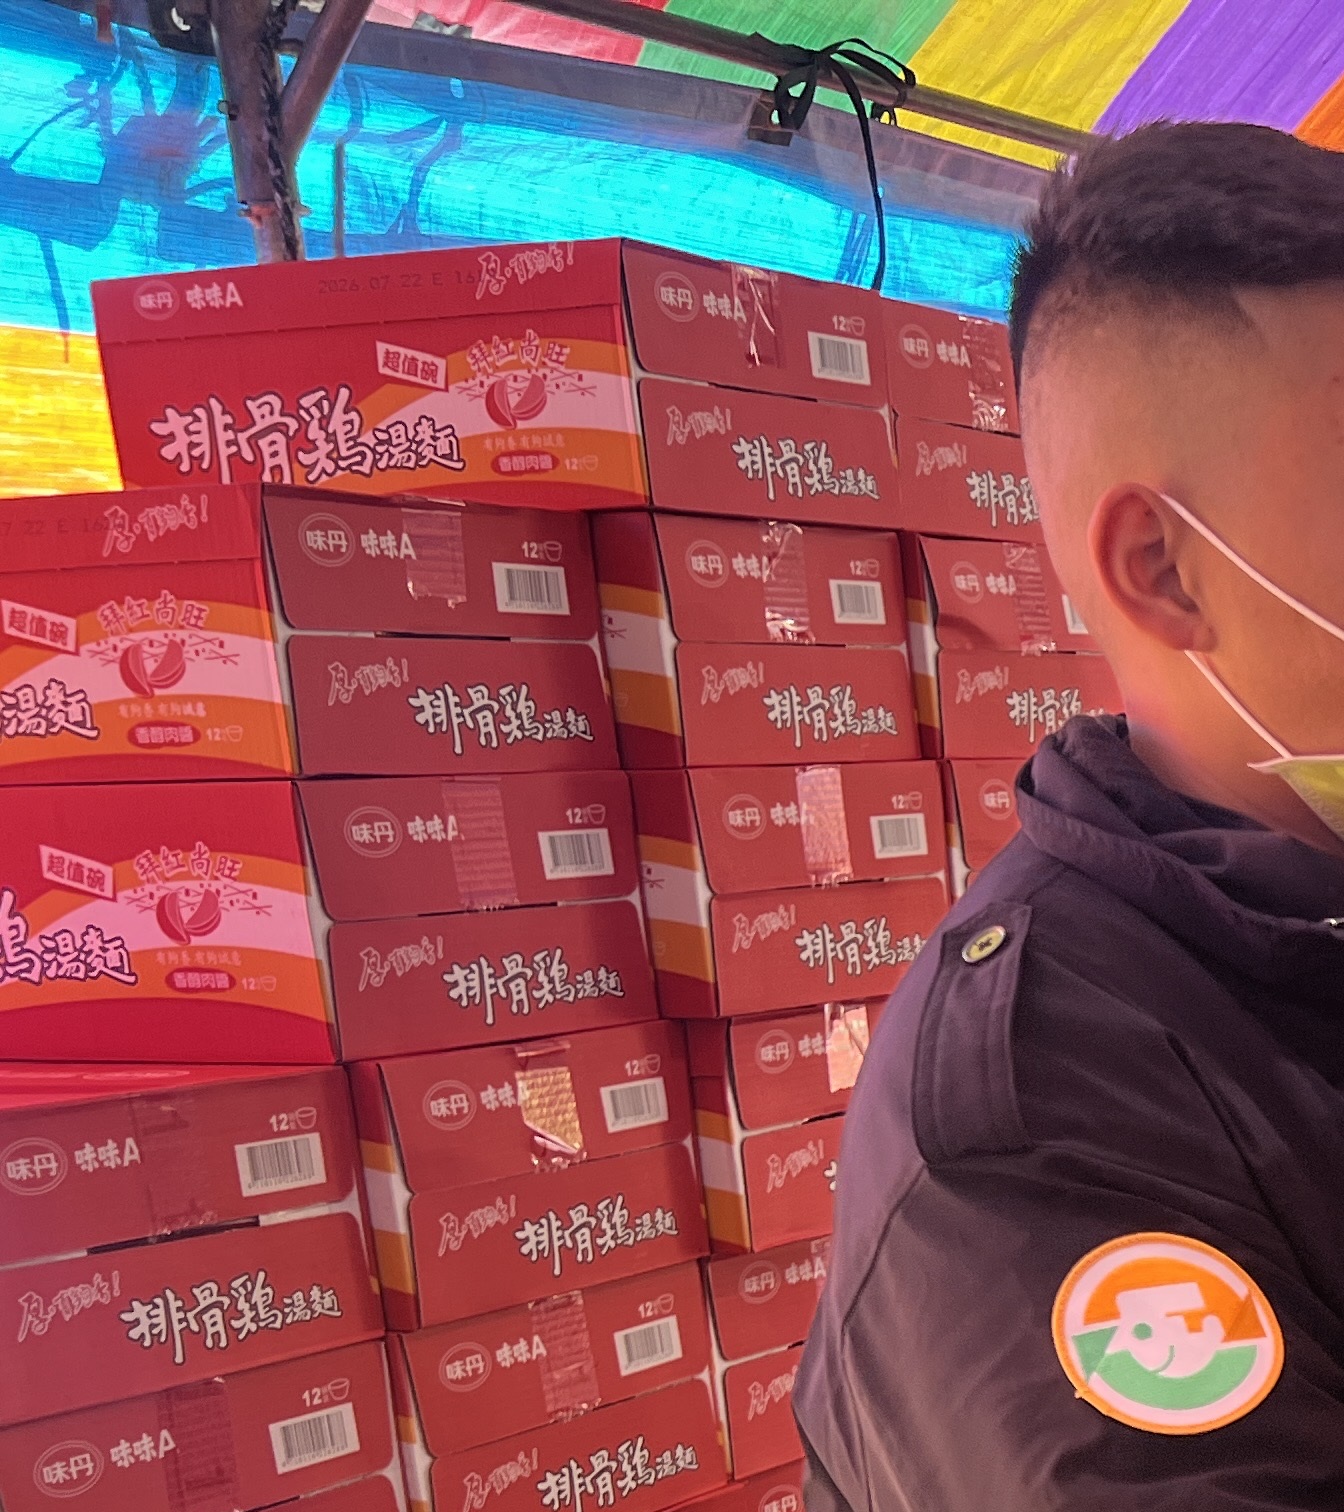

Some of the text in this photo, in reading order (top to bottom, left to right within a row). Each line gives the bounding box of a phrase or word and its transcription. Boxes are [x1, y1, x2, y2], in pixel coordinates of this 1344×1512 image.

[187, 283, 242, 309] 味味A
[660, 287, 745, 323] 味丹 味味A
[832, 316, 848, 331] 12
[904, 337, 970, 368] 味丹 味味A
[383, 348, 438, 383] 超值碗
[305, 530, 417, 560] 味丹 味味A
[522, 541, 539, 559] 12
[692, 555, 722, 575] 味丹
[954, 574, 980, 592] 味丹
[9, 608, 69, 645] 超值碗
[985, 790, 1009, 809] 味丹
[566, 808, 582, 823] 12
[729, 808, 760, 828] 味丹
[352, 816, 458, 843] 味丹 味味A
[45, 855, 107, 893] 超值碗
[760, 1042, 788, 1061] 味丹
[625, 1061, 640, 1075] 12
[430, 1095, 469, 1117] 味丹
[270, 1113, 288, 1132] 12
[7, 1138, 141, 1179] 味丹 味味A
[745, 1257, 826, 1291] 味丹 味味A
[638, 1303, 652, 1317] 12
[446, 1336, 546, 1379] 味丹 味味A
[303, 1388, 320, 1406] 12
[42, 1430, 176, 1484] 味丹 味味A
